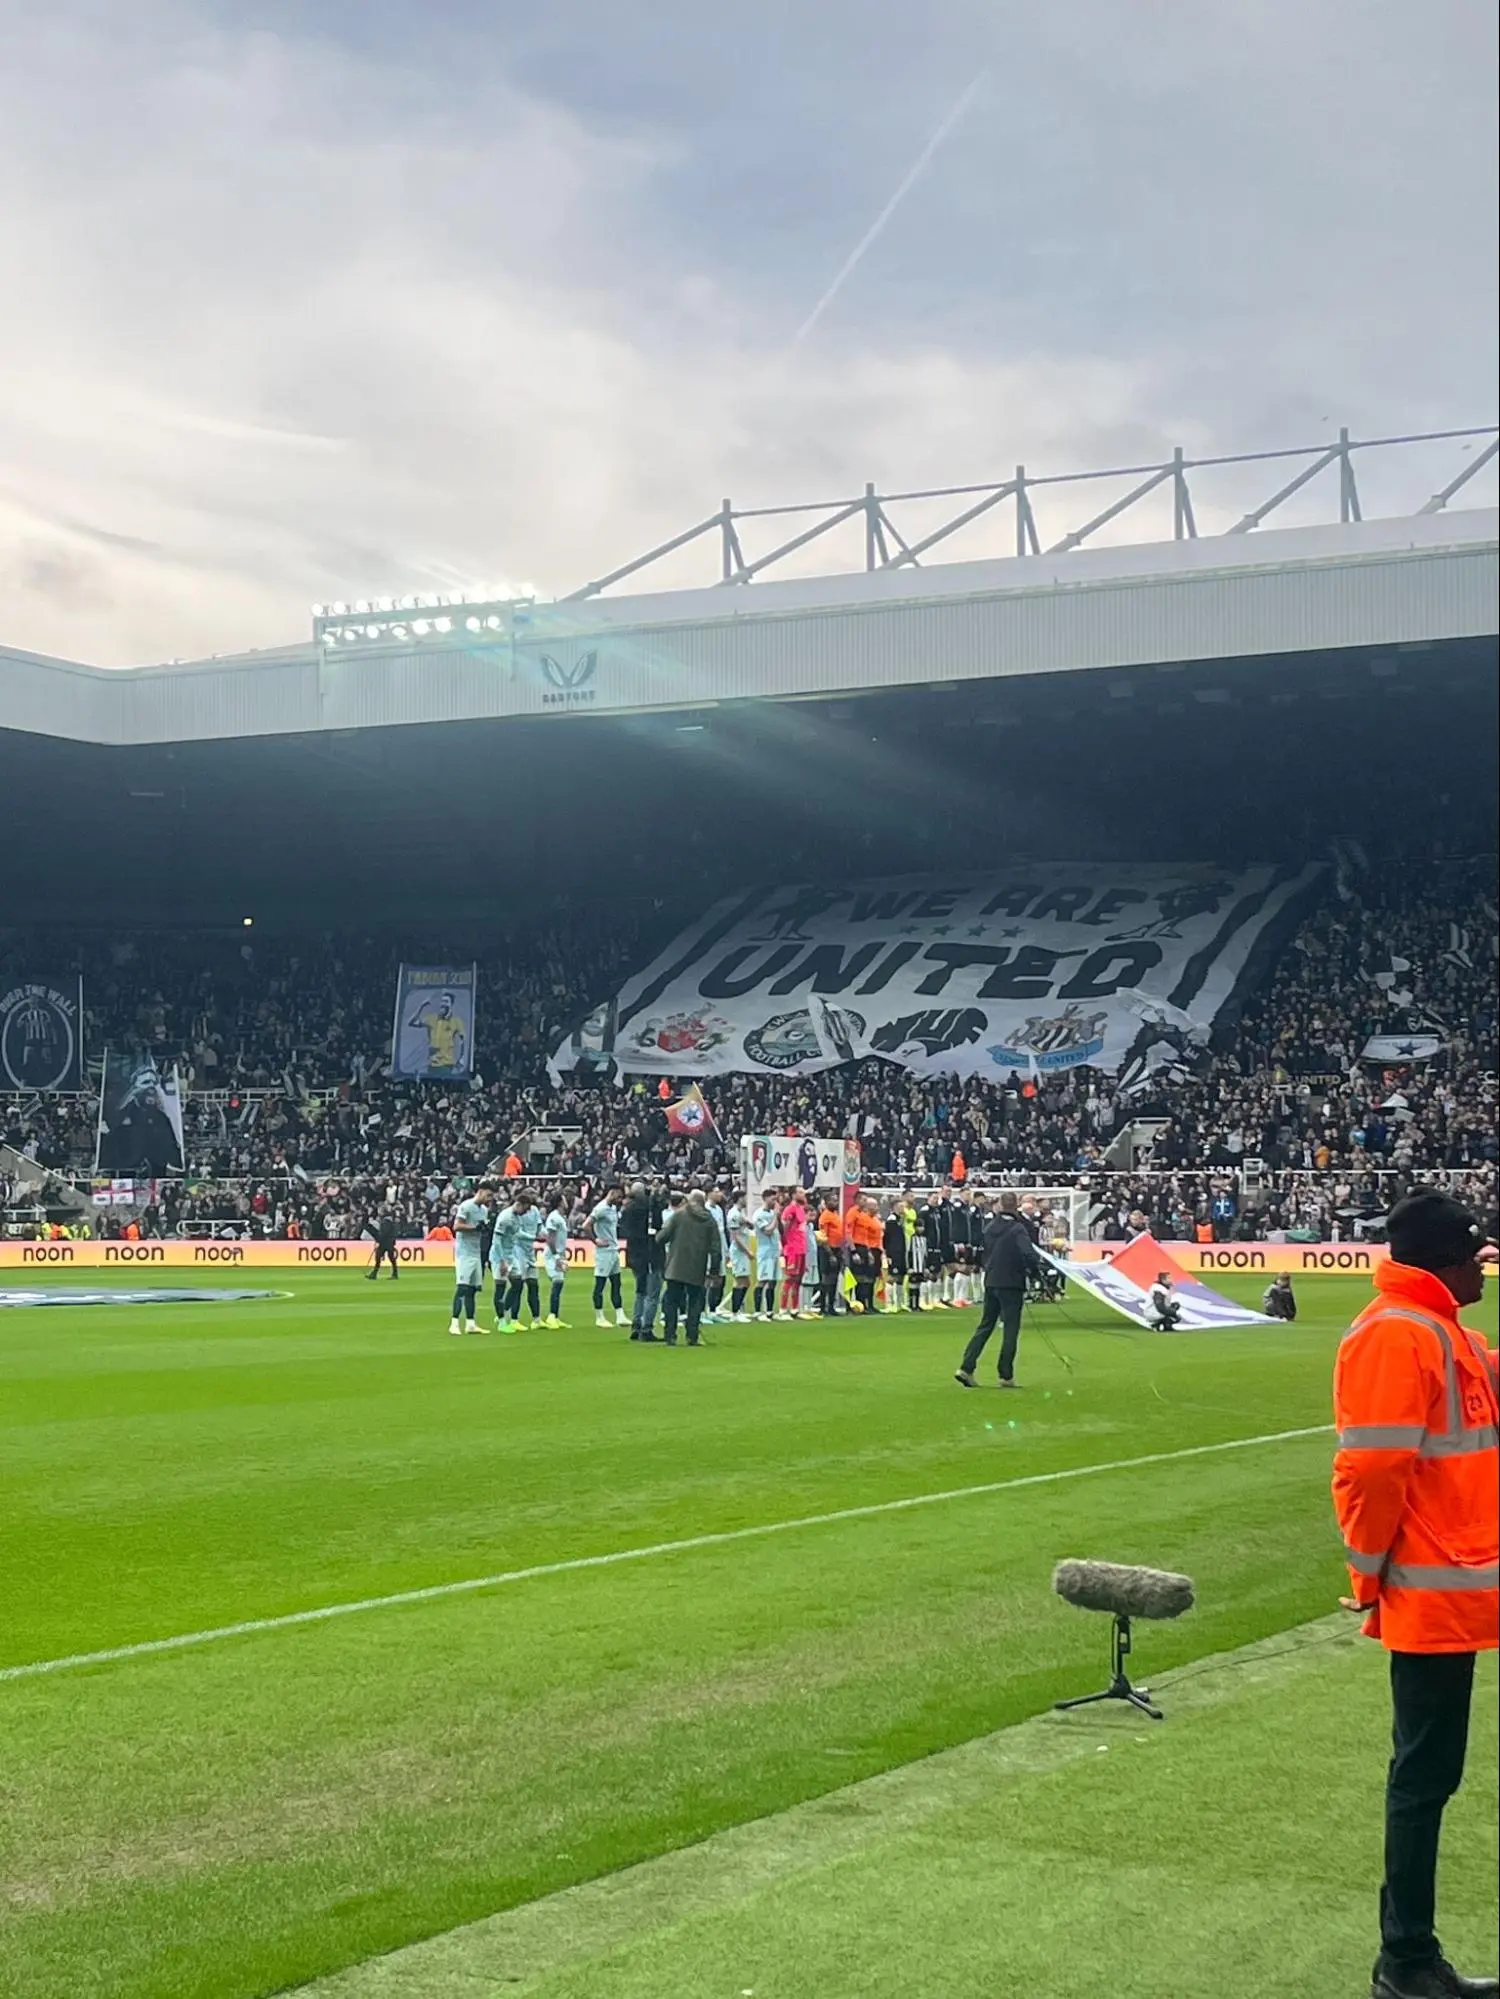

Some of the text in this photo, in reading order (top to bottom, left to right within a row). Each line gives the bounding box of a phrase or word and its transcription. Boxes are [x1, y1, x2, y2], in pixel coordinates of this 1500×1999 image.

[848, 884, 1148, 925] WE ARE
[699, 941, 1163, 1000] UNITED
[23, 1247, 74, 1261] noon
[106, 1246, 165, 1261] noon
[195, 1246, 244, 1261] noon
[298, 1246, 347, 1261] noon
[1200, 1251, 1265, 1268] noon
[1303, 1252, 1370, 1268] noon
